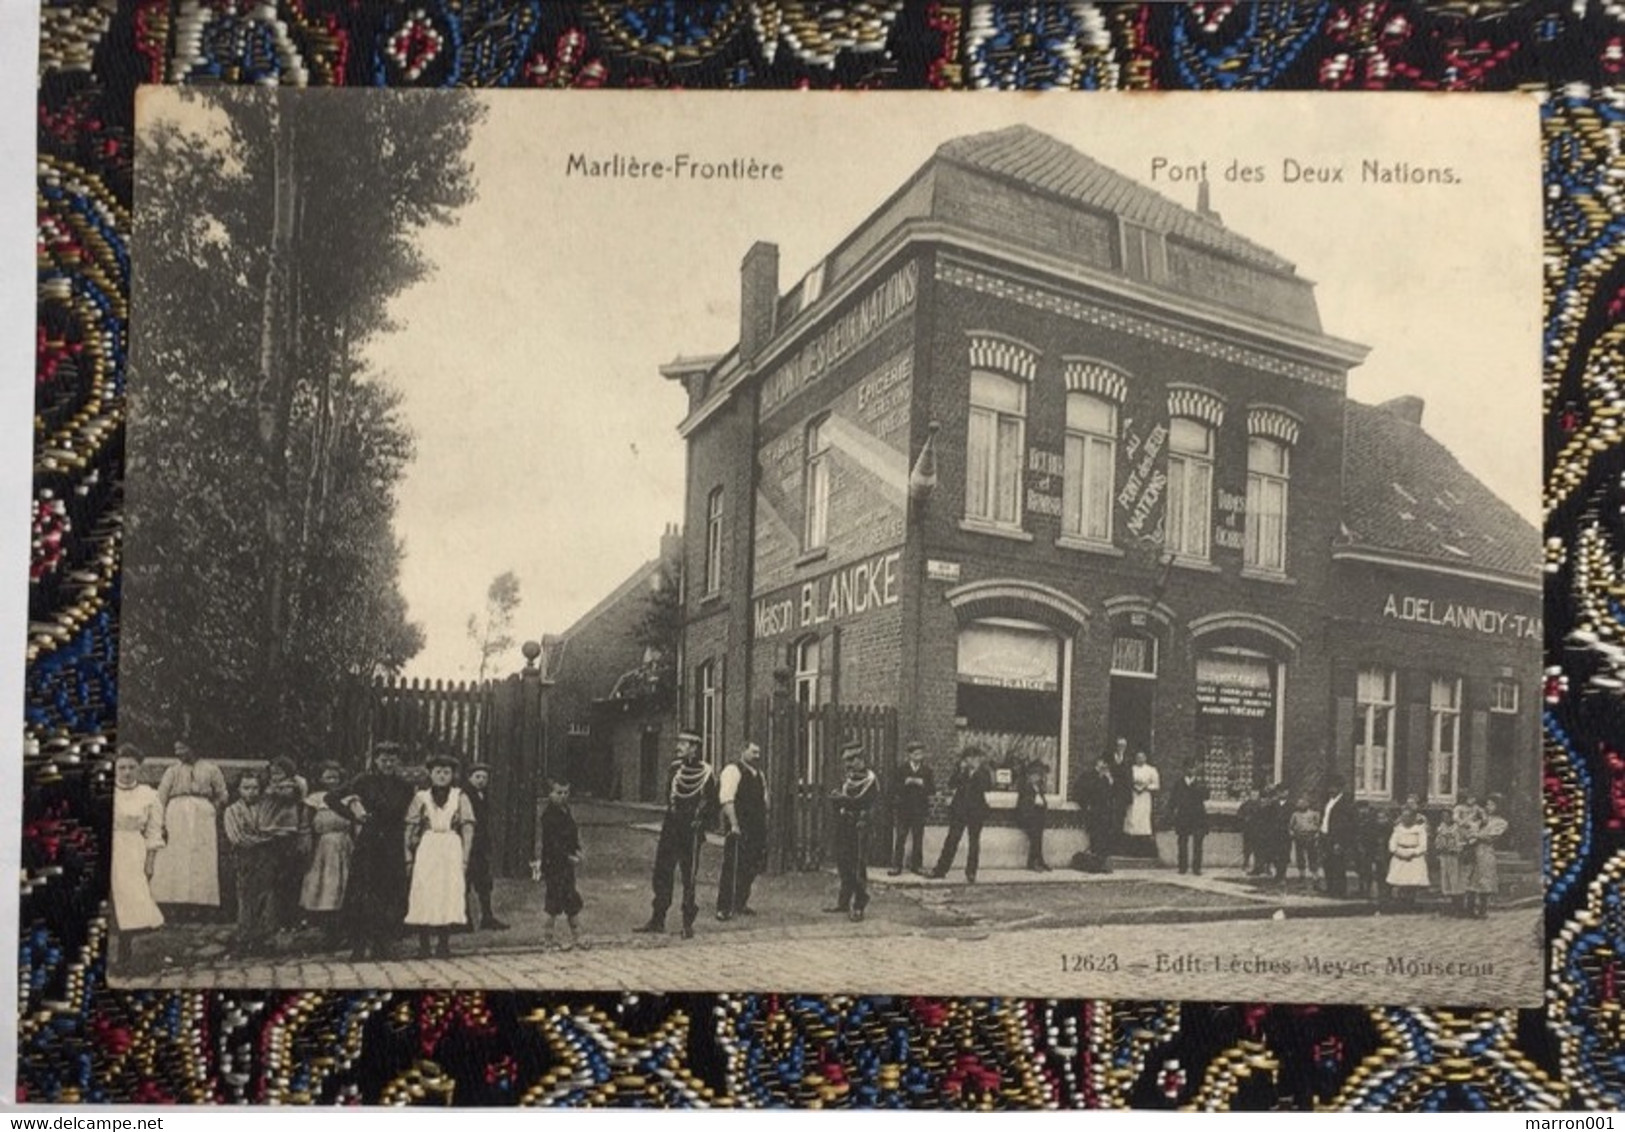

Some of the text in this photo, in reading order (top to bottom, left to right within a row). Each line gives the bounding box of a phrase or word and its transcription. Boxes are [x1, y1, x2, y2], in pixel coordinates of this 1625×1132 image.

[565, 153, 784, 180] Marlière-Frontière
[1151, 157, 1462, 185] Pont des Deux Nations.
[860, 258, 917, 342] NATIONS
[1118, 469, 1143, 511] PONT
[1126, 469, 1167, 536] NATIONS
[801, 552, 901, 628] BLANCKE
[1060, 953, 1120, 973] 12623
